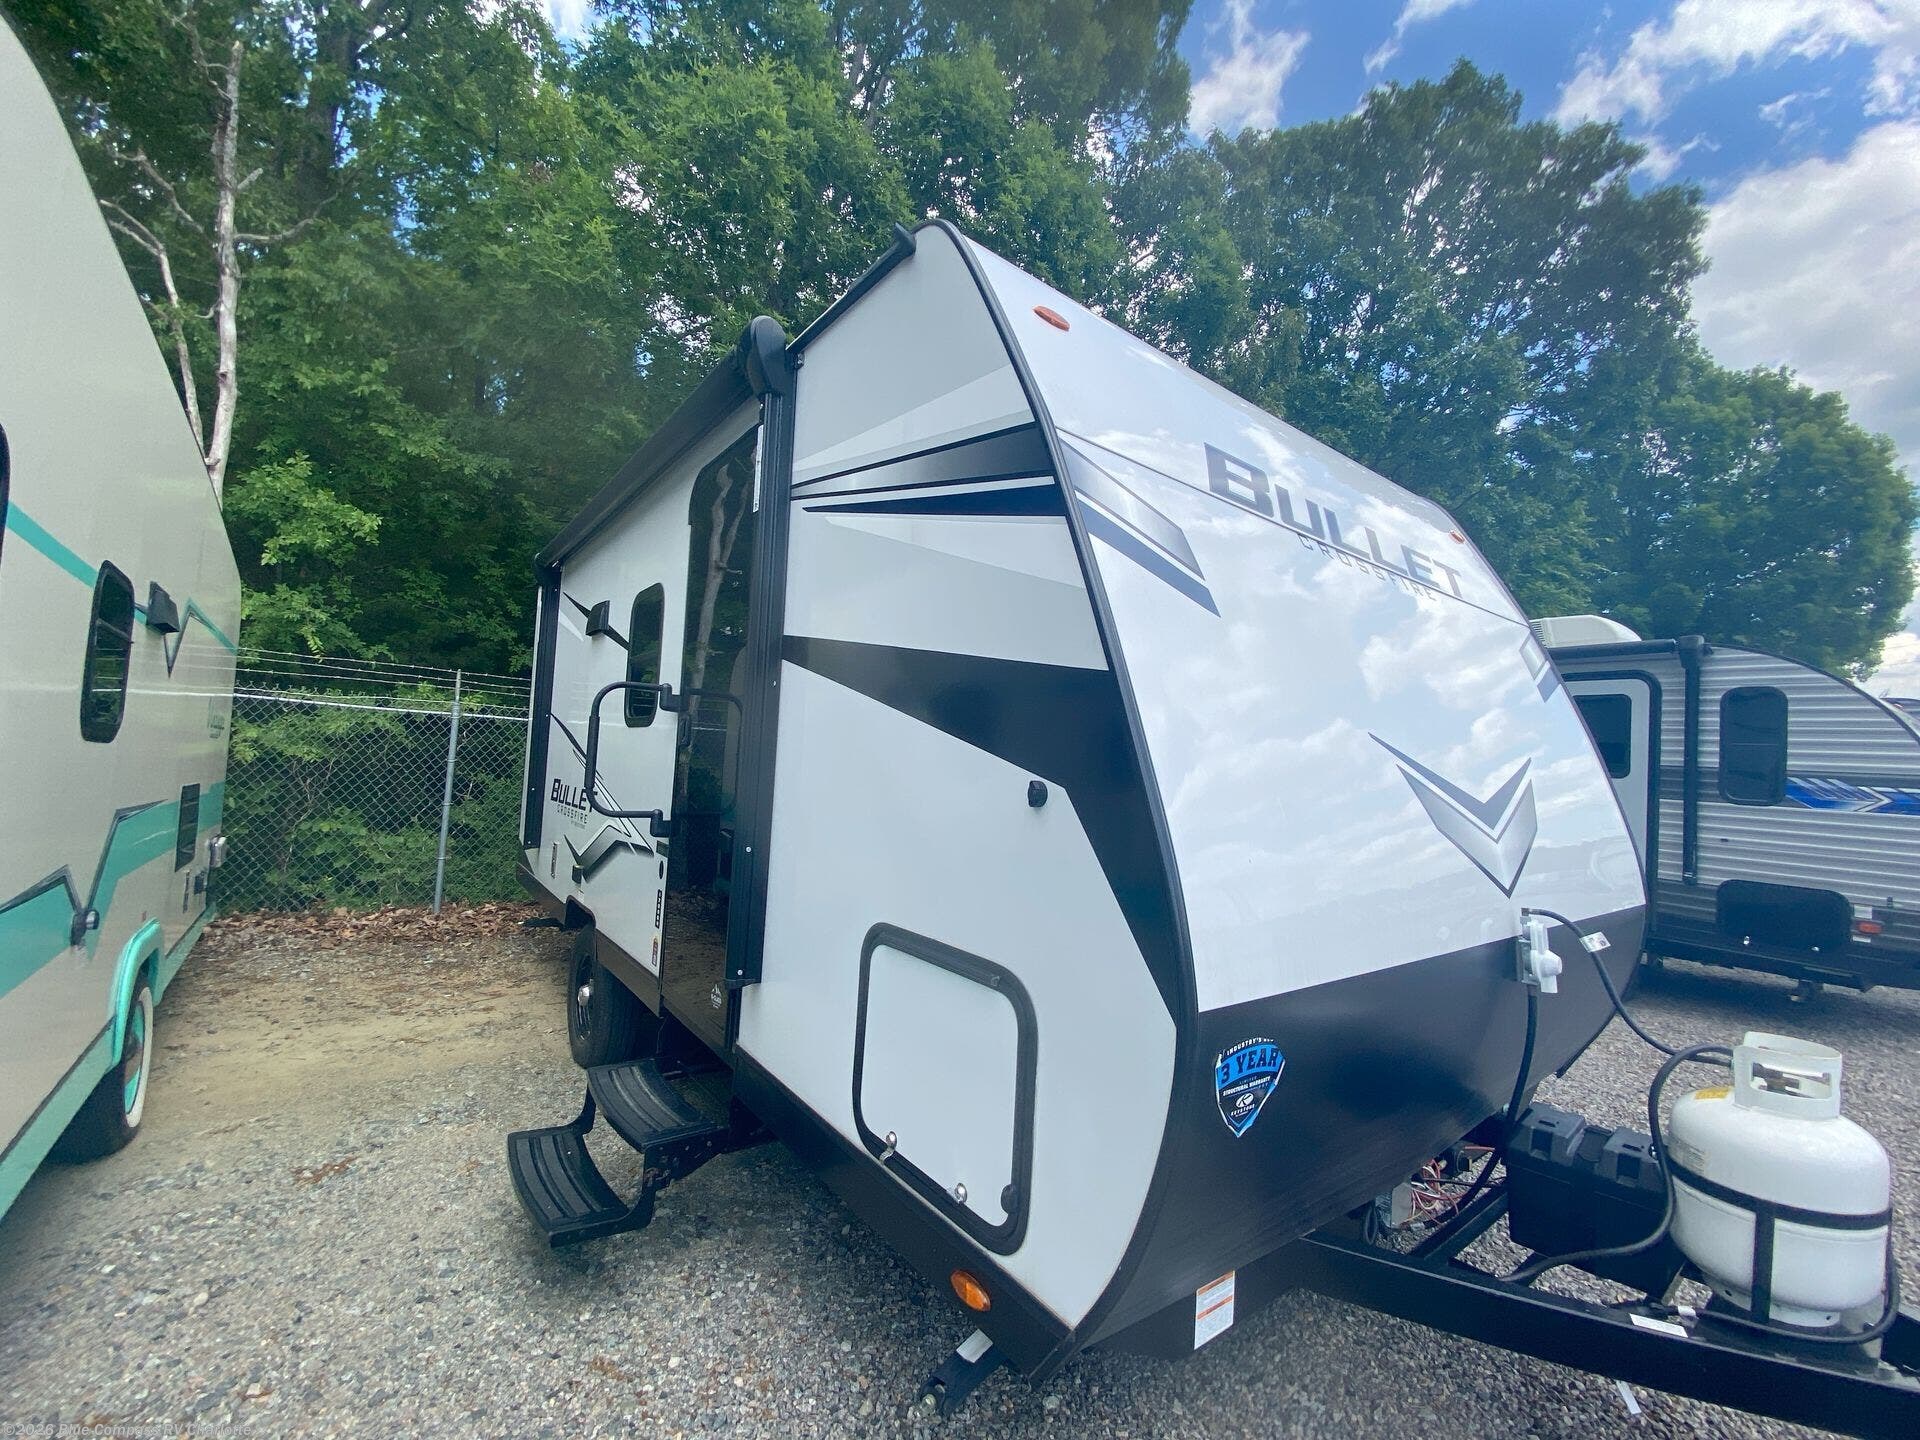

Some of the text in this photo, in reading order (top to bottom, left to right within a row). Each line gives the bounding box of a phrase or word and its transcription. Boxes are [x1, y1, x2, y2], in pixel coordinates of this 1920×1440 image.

[1204, 442, 1463, 598] BULLET
[1297, 534, 1437, 602] CROSSFIRE
[557, 804, 587, 824] CROSSFIRE
[1226, 1037, 1262, 1056] INDUSTRY'S
[1221, 1063, 1230, 1084] 3
[1236, 1048, 1278, 1073] YEAR
